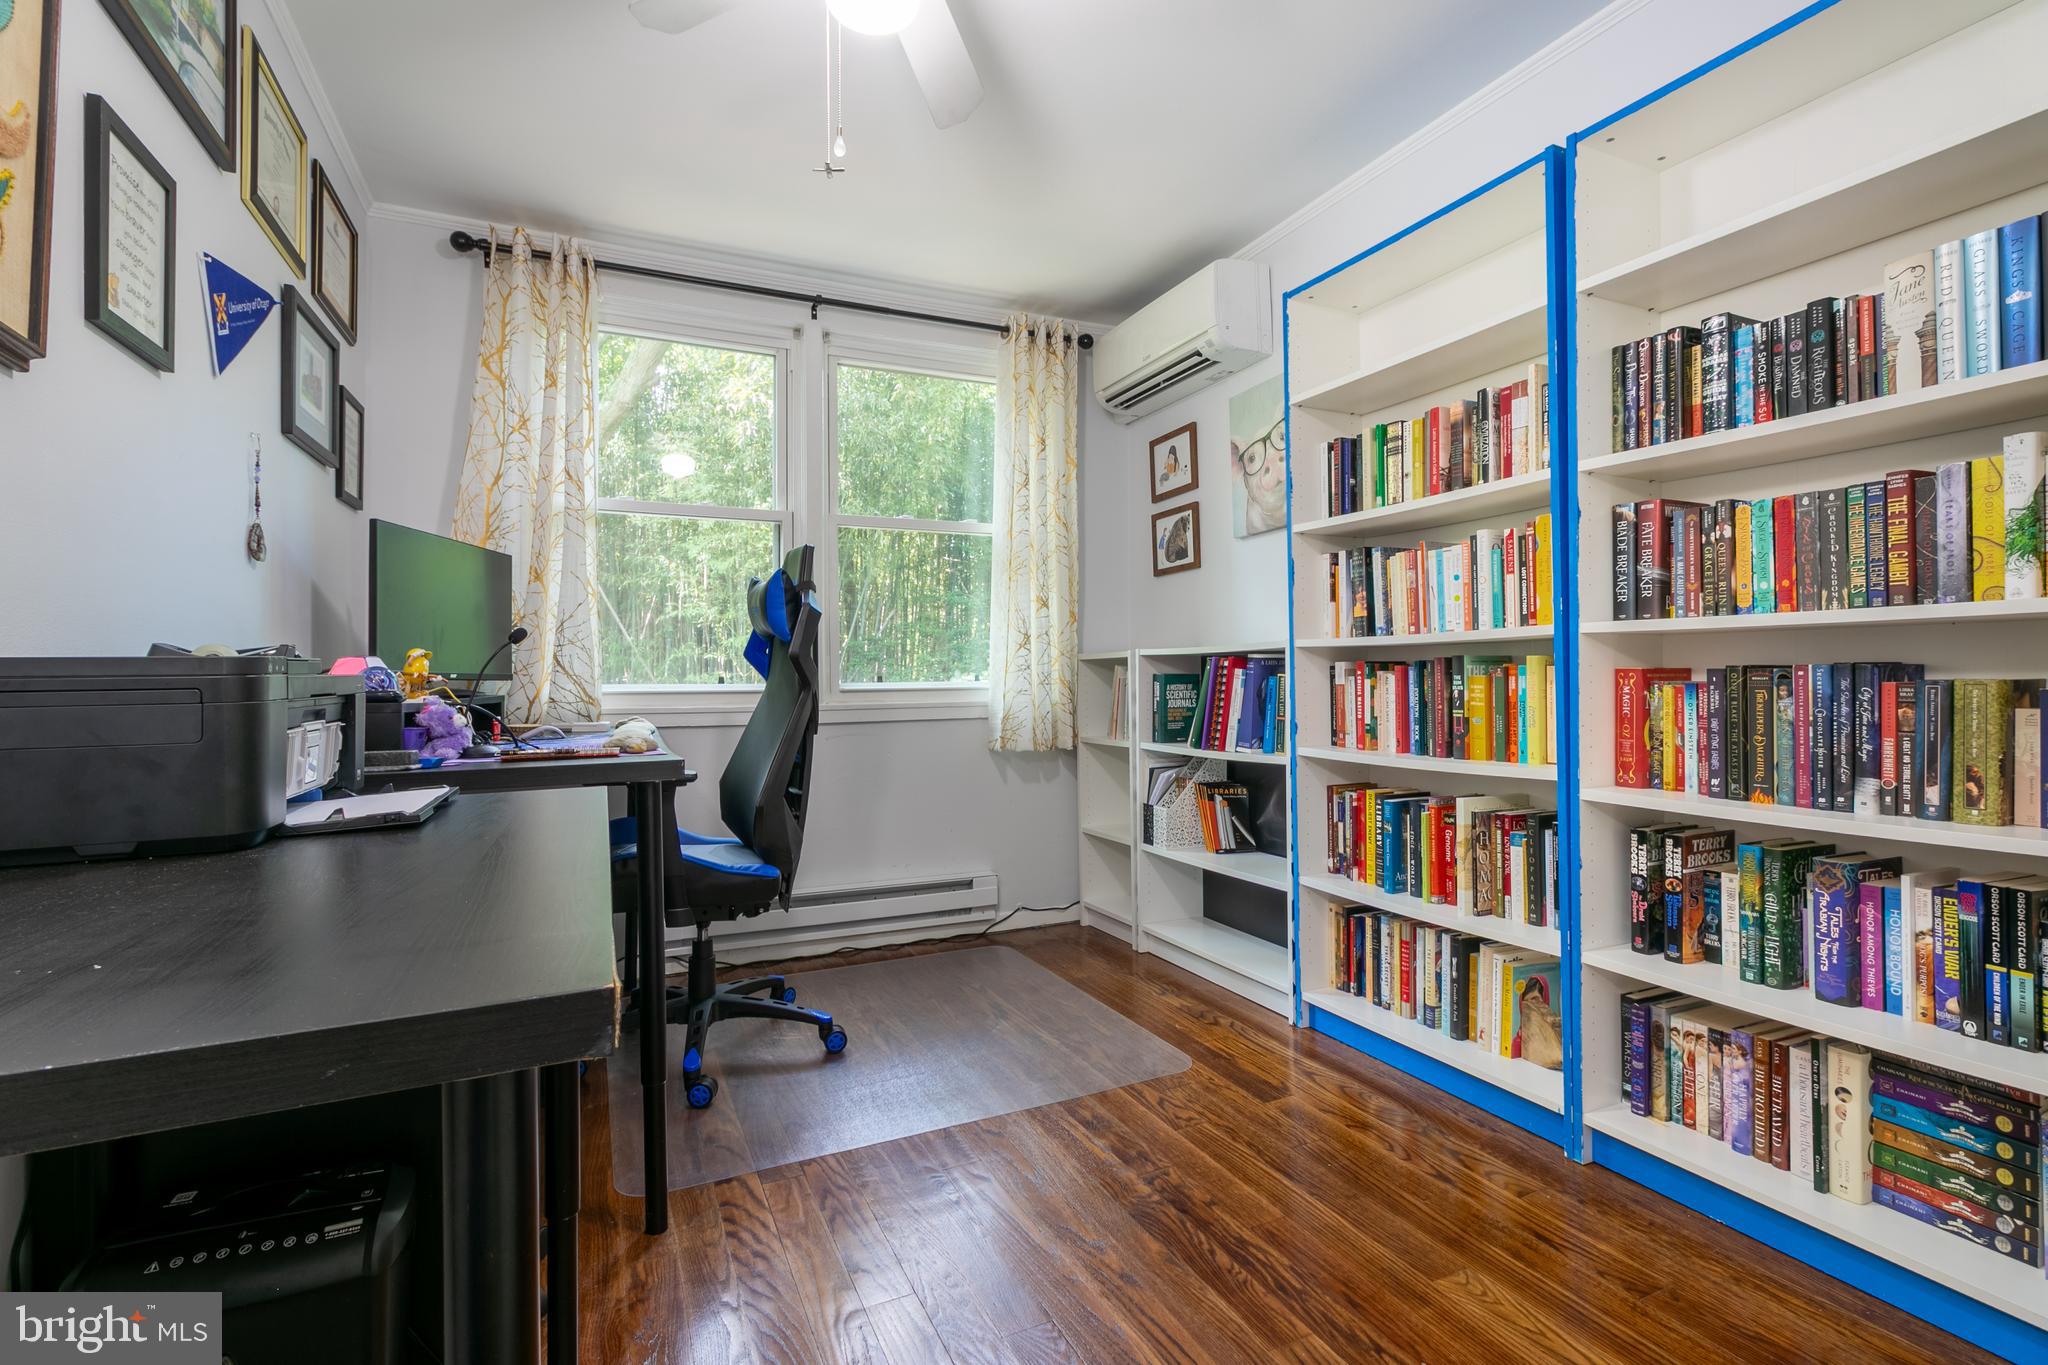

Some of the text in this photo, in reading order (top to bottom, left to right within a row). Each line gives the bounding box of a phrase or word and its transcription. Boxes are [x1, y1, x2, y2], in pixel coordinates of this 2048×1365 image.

[1940, 262, 1953, 297] RED
[1973, 248, 1986, 297] GLASS
[228, 299, 252, 314] University
[1638, 338, 1650, 368] Queen
[1848, 338, 1857, 366] speak
[1938, 316, 1955, 381] QUEEN
[1976, 319, 1989, 375] SWORD
[2012, 310, 2026, 354] CAGE
[1624, 362, 1637, 387] Dream
[1624, 386, 1637, 407] Thief
[1638, 373, 1649, 407] Dragons
[1790, 355, 1802, 399] DAMNED
[1811, 346, 1826, 405] RIGHTEOUS
[1480, 420, 1489, 465] CIVILIZATION
[1848, 500, 1865, 516] THE
[1616, 520, 1628, 602] BLADE BREAKER
[1640, 521, 1653, 598] FATE BREAKER
[1756, 520, 1768, 579] SIEGE STORM
[1827, 507, 1839, 599] CROOKED KINGDOM
[1868, 502, 1885, 591] THE HAWTHORNE LEGACY
[1888, 495, 1909, 587] THE FINAL GAMBIT
[1677, 561, 1685, 574] MAN
[1677, 575, 1685, 594] CALLED
[1703, 546, 1714, 607] GRACE FURY
[1717, 542, 1727, 606] QUEEN RUIN
[1850, 565, 1866, 594] GAMES
[1677, 595, 1685, 607] OVE
[1165, 690, 1198, 699] SCIENTIFIC
[1167, 699, 1197, 708] JOURNALS
[1622, 685, 1631, 737] MAGIC OZ
[1730, 672, 1738, 722] OLIVIE BLAKE
[1839, 690, 1850, 717] Garden
[1753, 689, 1769, 782] FIREKEEPER'S DAUGHTER
[1813, 668, 1827, 769] SECRETS CHOCOLATE HOUSE
[1840, 724, 1850, 754] Promises
[1840, 754, 1849, 767] and
[1883, 737, 1894, 778] FAHRENHEIT
[1375, 804, 1383, 848] LIBRARY
[1444, 828, 1453, 863] Genome
[1691, 834, 1727, 852] TERRY
[1528, 829, 1536, 911] CLEOPATRA
[1630, 833, 1638, 875] BROOKS
[1638, 843, 1648, 878] TERRY
[1665, 837, 1674, 878] BROOKS
[1673, 847, 1683, 880] TERRY
[1686, 848, 1731, 869] BROOKS
[1771, 861, 1781, 883] TERRY
[1637, 900, 1648, 922] Druid
[1763, 892, 1781, 972] CHILD OF LIGHT
[1814, 888, 1832, 972] ARABIAN NIGHTS
[1934, 895, 1943, 955] ORSON SCOTT CARD
[1991, 887, 2001, 964] ORSON SCOTT CARD
[2016, 891, 2027, 970] ORSON SCOTT CARD
[1865, 901, 1877, 998] HONOR AMONG THIEVES
[1889, 909, 1902, 997] HONOR BOUND
[1943, 897, 1960, 980] ENDER'S WAR
[1993, 972, 2001, 995] CHILDREN
[1993, 1002, 2001, 1012] THE
[1993, 1012, 2001, 1026] MIND
[1623, 1031, 1633, 1078] WAKERS
[1671, 1061, 1681, 1110] SELECTION
[1683, 1068, 1695, 1099] ELITE
[1709, 1079, 1721, 1110] HEIR
[1798, 1071, 1811, 1119] thousand
[1755, 1069, 1766, 1147] BETROTHED
[1771, 1078, 1783, 1147] BETRAYED
[1798, 1118, 1812, 1170] heartbeats
